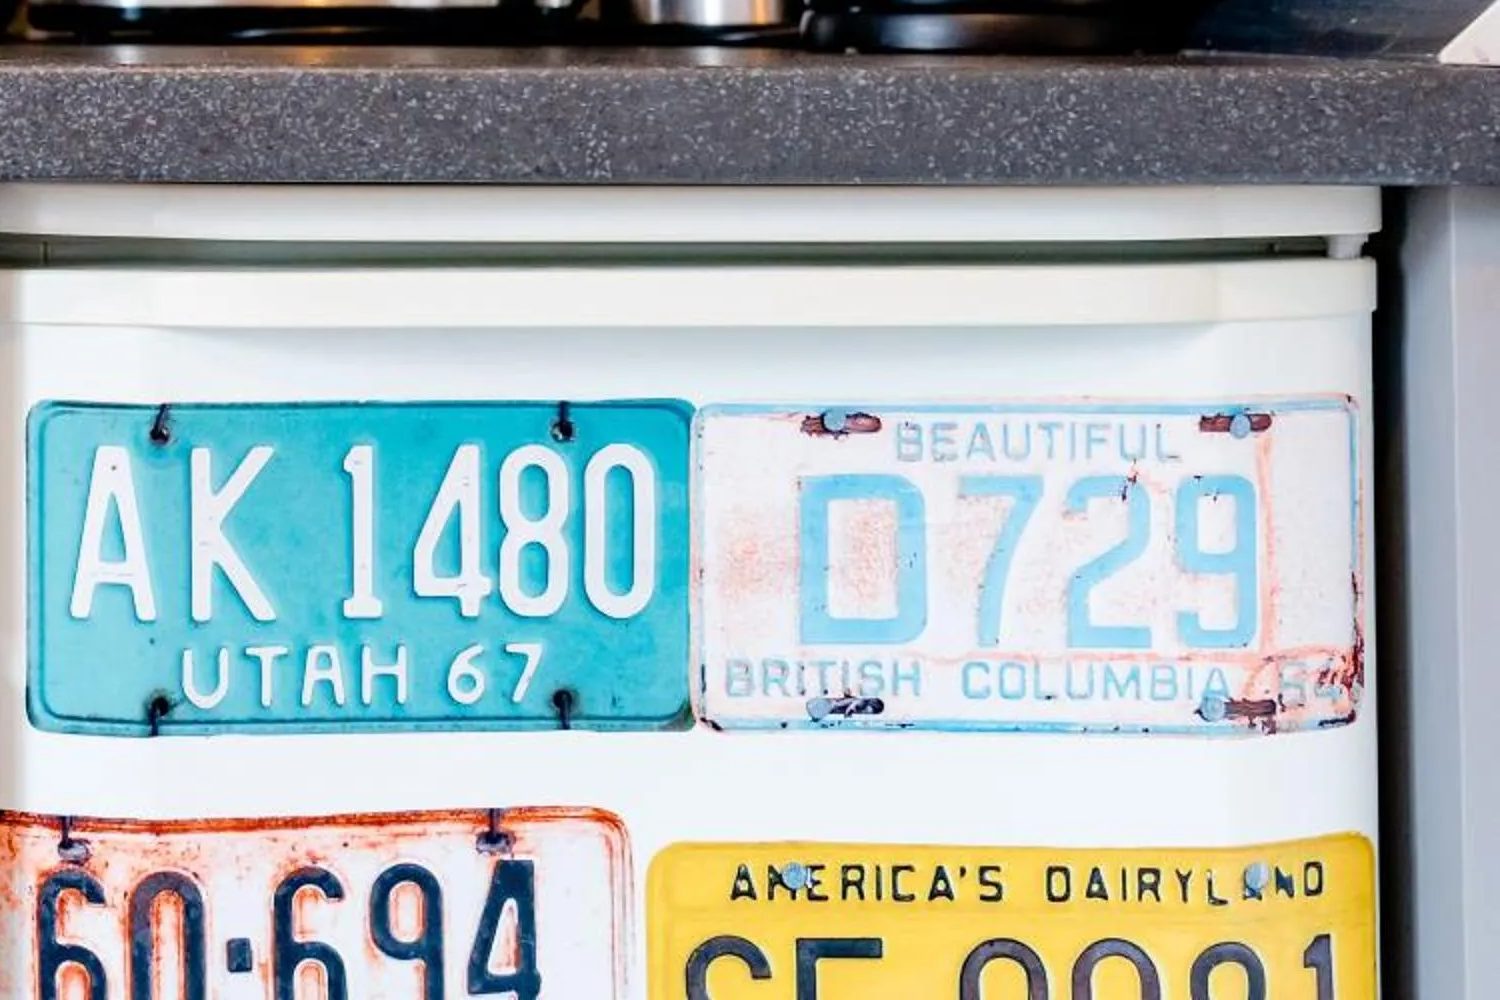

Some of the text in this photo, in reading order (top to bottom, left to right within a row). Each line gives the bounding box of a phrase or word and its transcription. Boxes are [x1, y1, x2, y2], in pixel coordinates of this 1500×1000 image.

[896, 421, 1182, 463] BEAUTIFUL
[70, 443, 656, 622] AK 1480
[182, 643, 545, 709] UTAH 67
[725, 657, 922, 698] BRITISH
[961, 659, 1230, 703] COLUMBIA
[730, 863, 1004, 901] AMERICA'S
